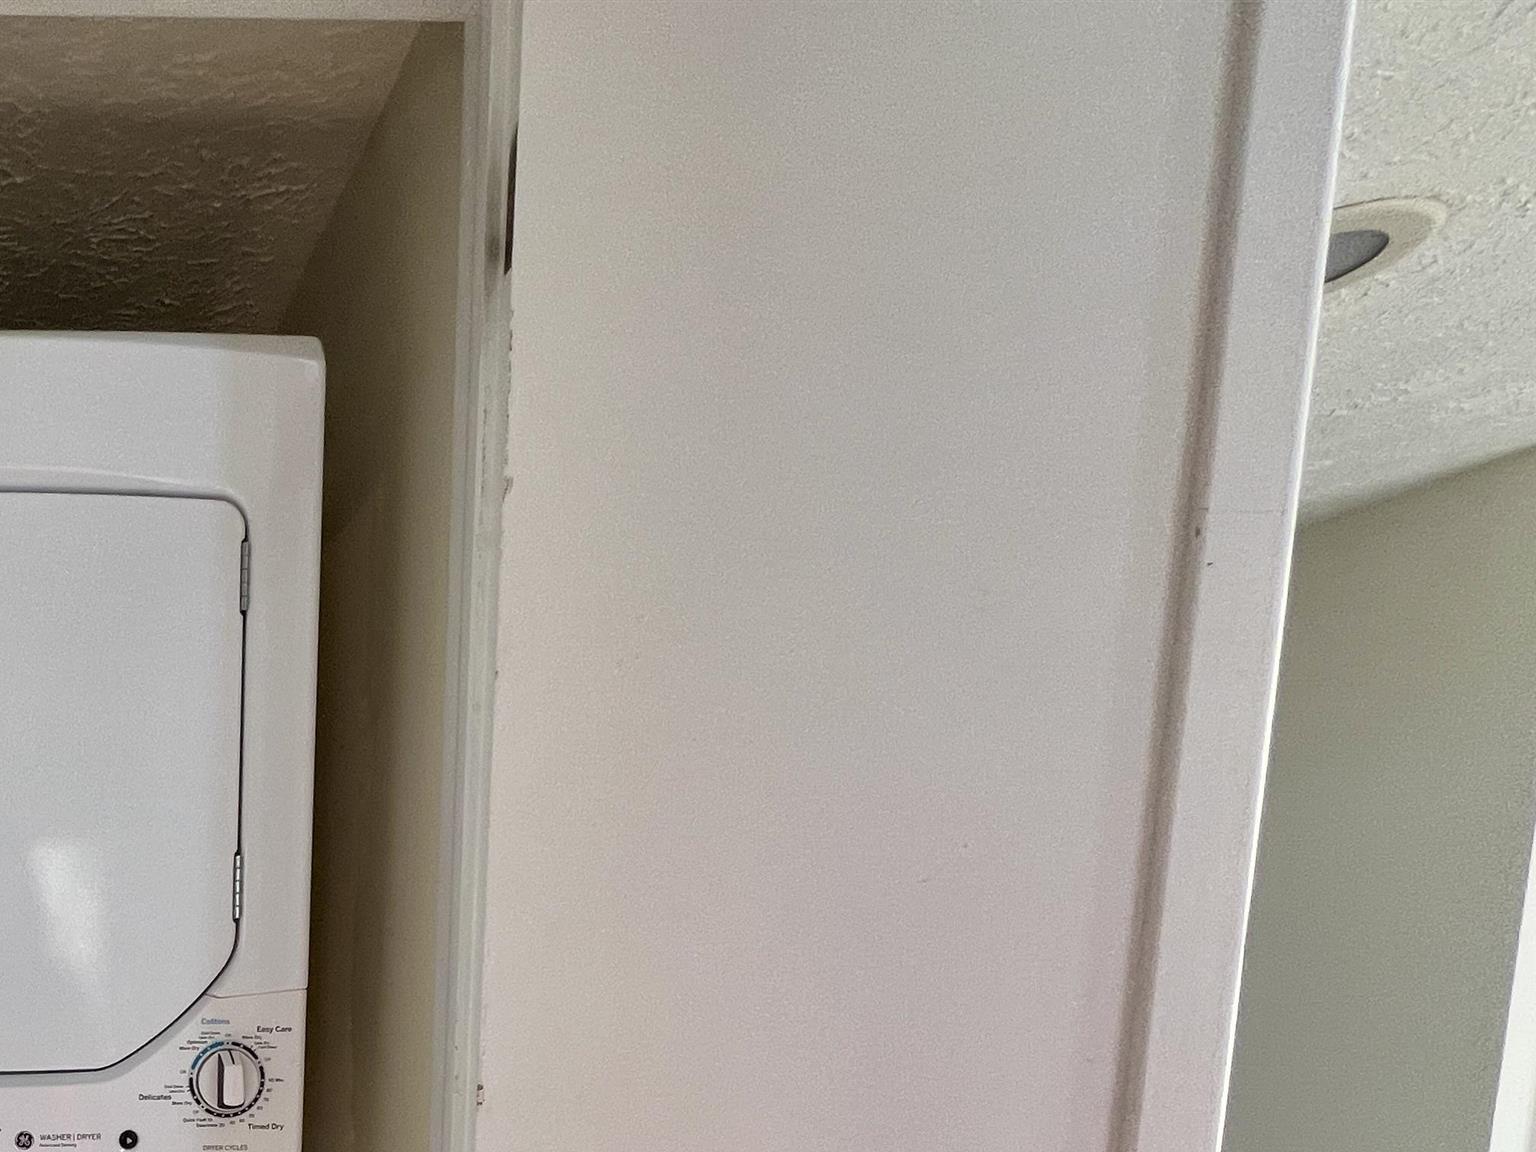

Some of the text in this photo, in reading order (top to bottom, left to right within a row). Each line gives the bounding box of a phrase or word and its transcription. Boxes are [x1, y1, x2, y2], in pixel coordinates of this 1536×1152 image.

[257, 1026, 274, 1034] Easy
[271, 1123, 284, 1131] Dry
[40, 1132, 102, 1141] WASHER DRYER
